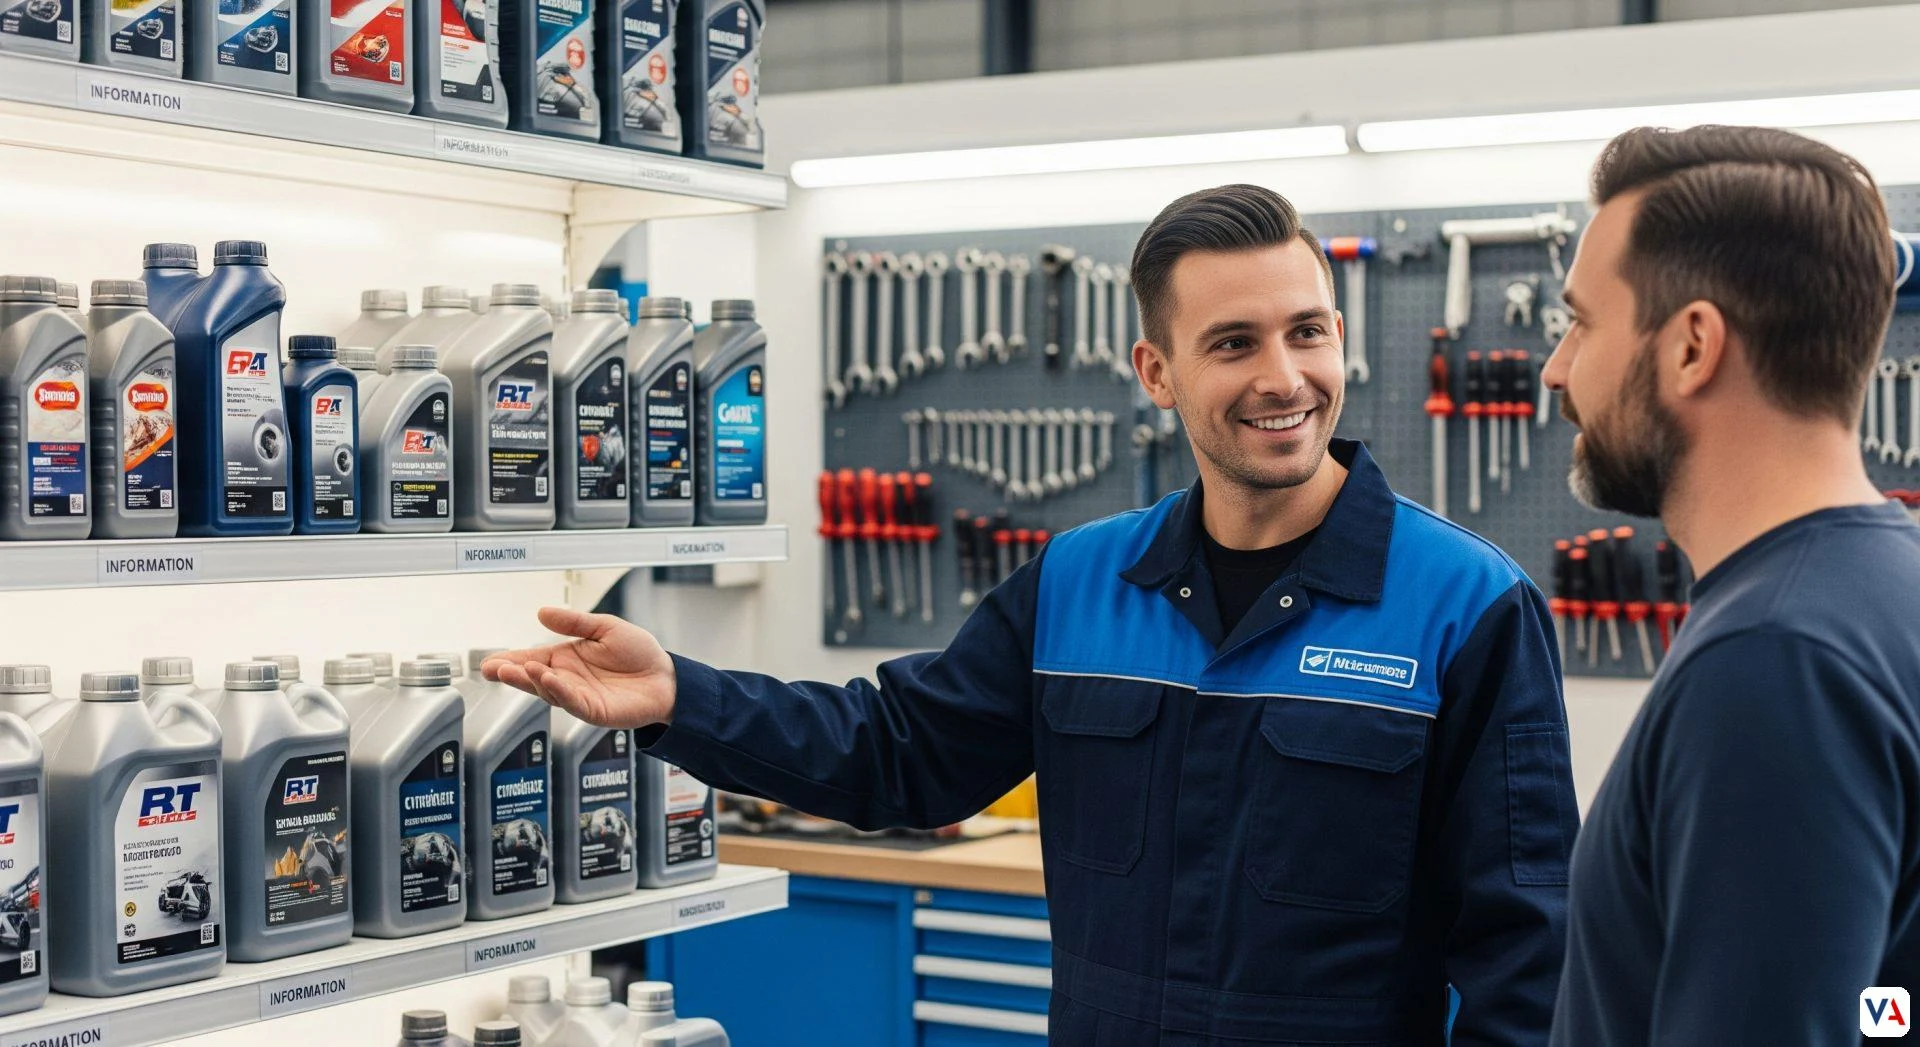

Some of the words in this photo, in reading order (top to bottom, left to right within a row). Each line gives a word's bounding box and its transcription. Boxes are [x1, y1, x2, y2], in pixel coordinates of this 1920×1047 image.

[90, 84, 181, 110] INFORMATION
[106, 557, 194, 573] INFORMATION
[140, 782, 201, 818] RT
[286, 778, 317, 797] RT
[269, 978, 346, 1006] INFORMATION
